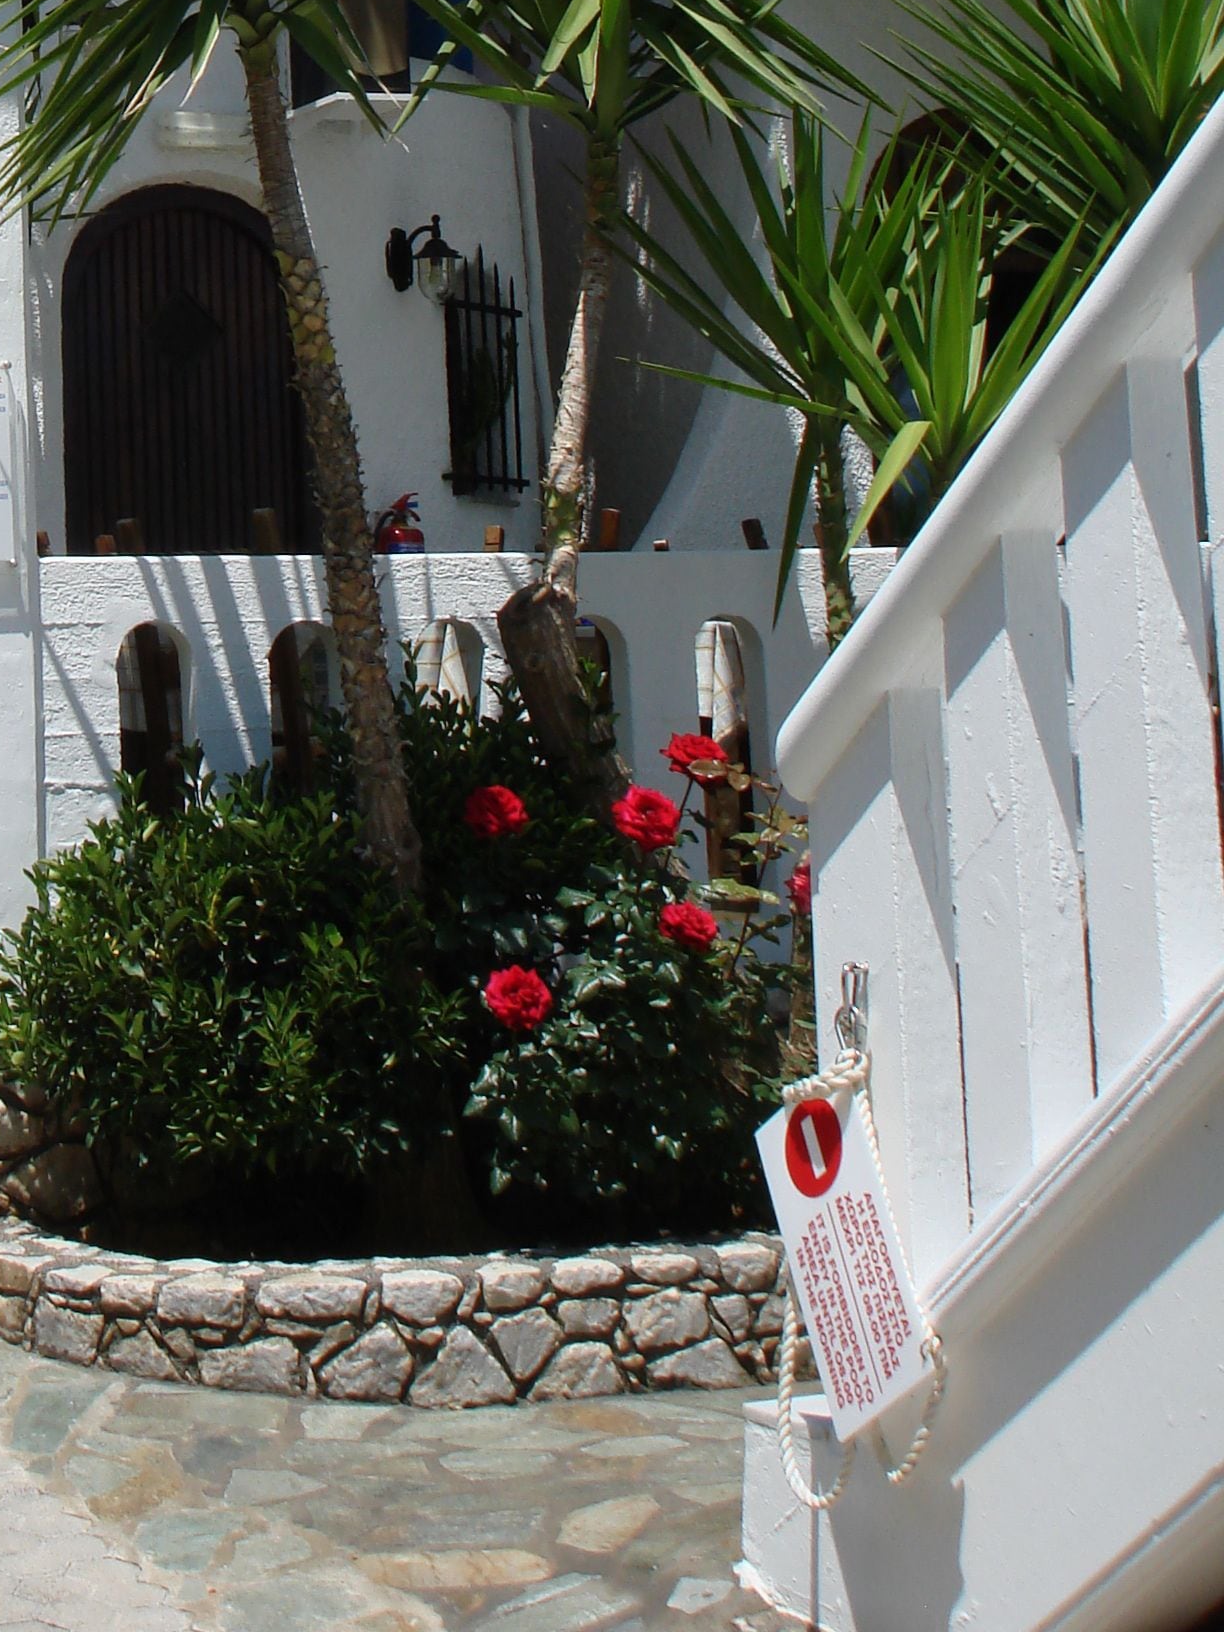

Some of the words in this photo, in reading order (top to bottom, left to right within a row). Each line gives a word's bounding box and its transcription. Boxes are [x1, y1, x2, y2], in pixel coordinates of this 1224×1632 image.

[856, 1200, 865, 1215] Η
[795, 1248, 806, 1268] IN
[803, 1271, 817, 1311] THE
[814, 1314, 845, 1409] MORNING
[801, 1236, 820, 1286] AREA
[817, 1290, 836, 1346] UNTIL
[807, 1220, 830, 1281] ENTRY
[826, 1287, 837, 1308] IN
[834, 1312, 849, 1351] THE
[845, 1355, 864, 1411] POOL
[815, 1213, 826, 1229] IT
[821, 1234, 831, 1254] IS
[828, 1258, 865, 1371] FORBIDDEN
[862, 1375, 874, 1404] TO
